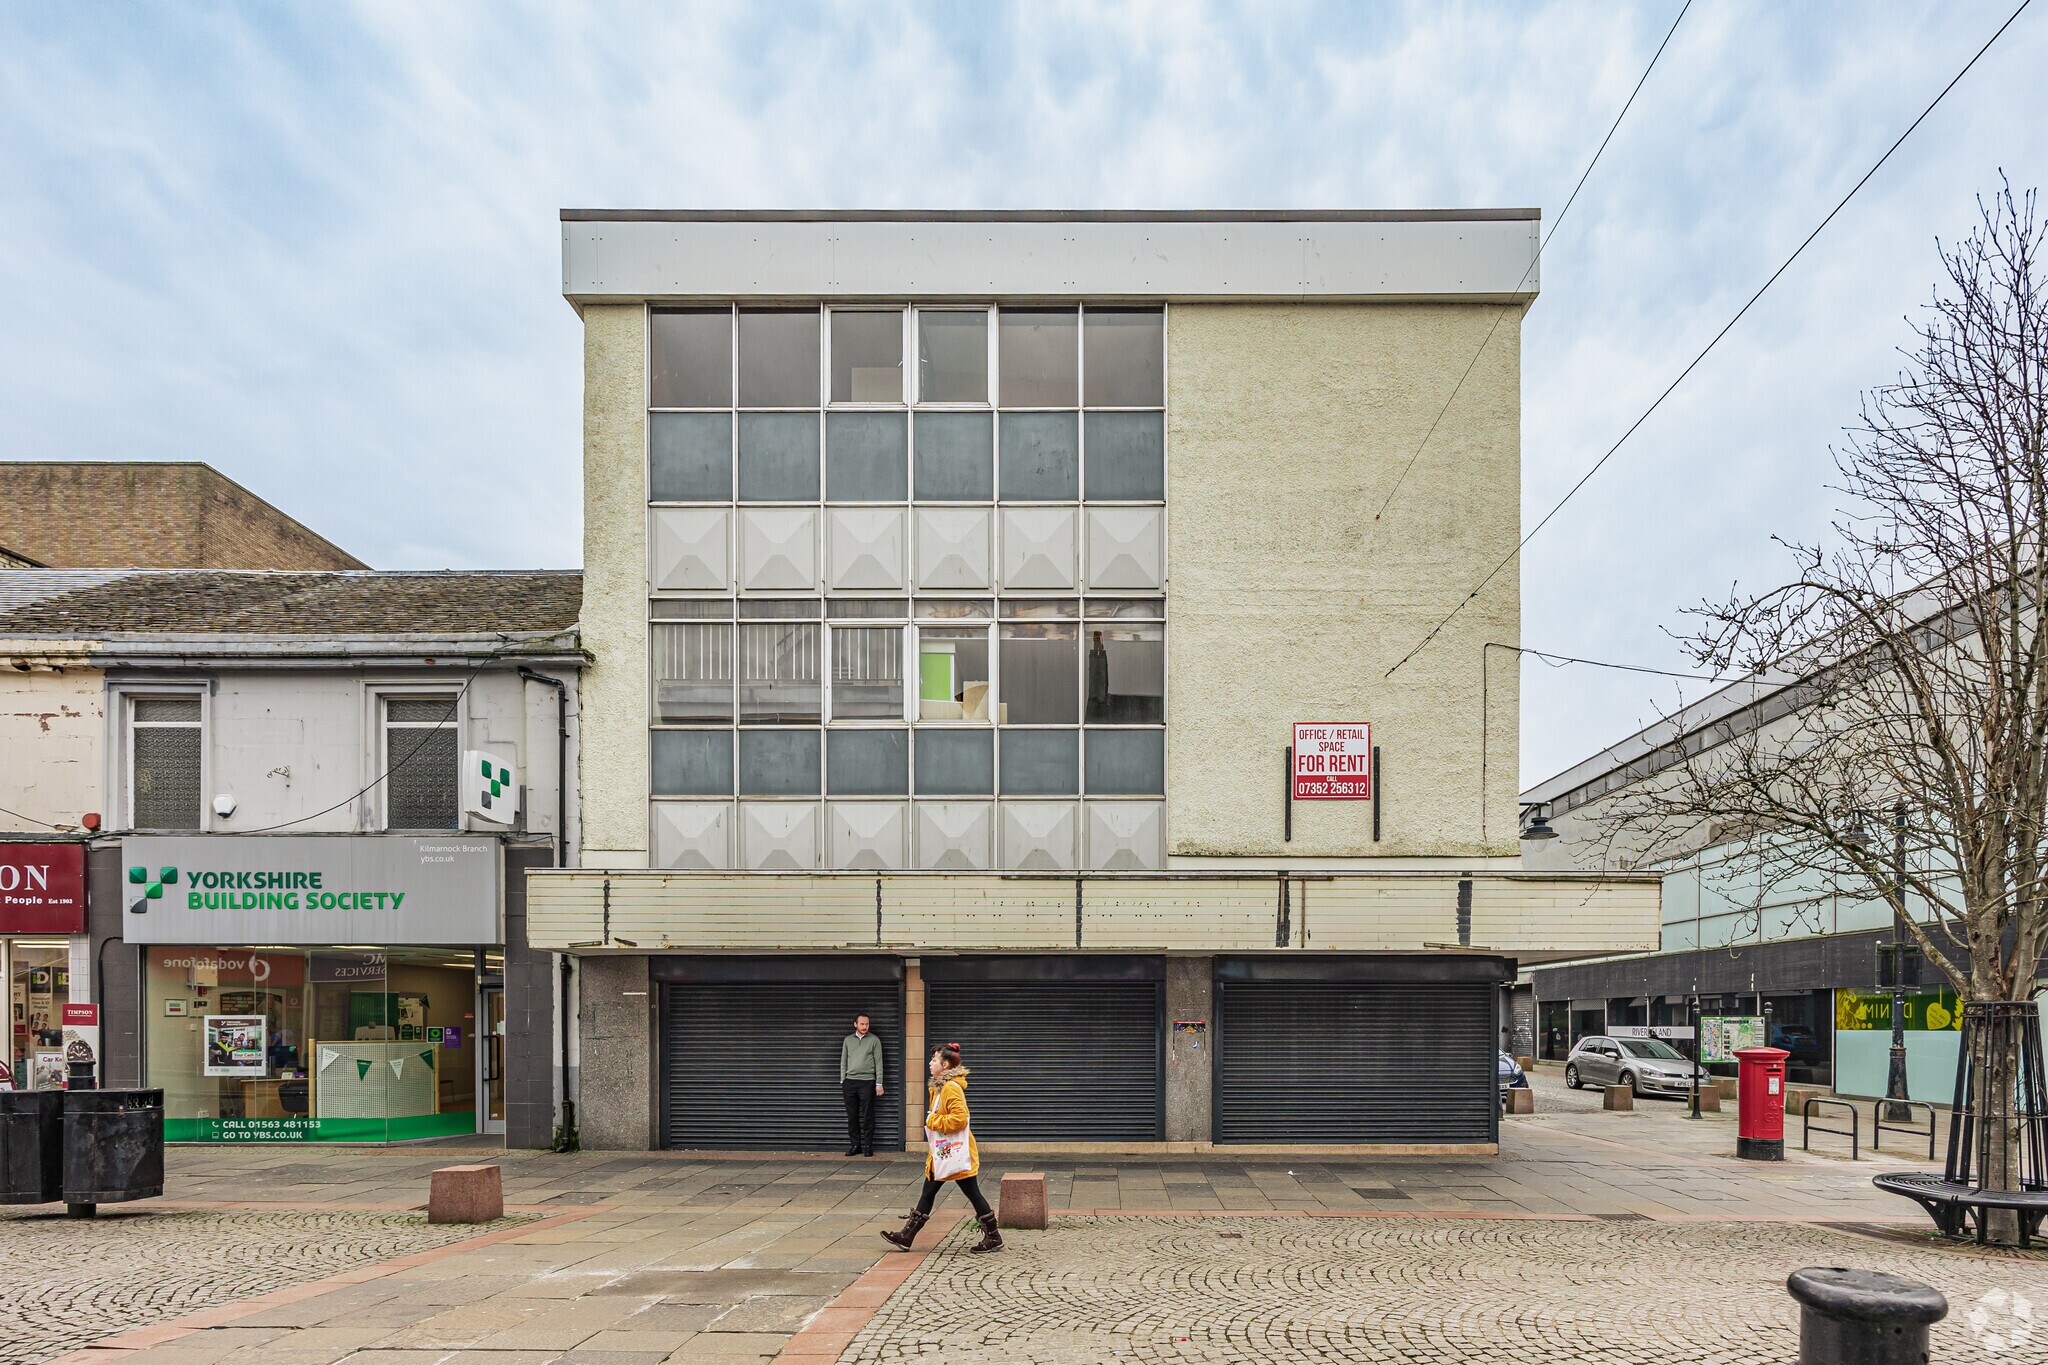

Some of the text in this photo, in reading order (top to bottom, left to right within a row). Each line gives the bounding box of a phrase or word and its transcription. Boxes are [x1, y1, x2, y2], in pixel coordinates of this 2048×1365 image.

[1299, 729, 1365, 740] OFFICE / RETAIL
[1318, 741, 1345, 752] SPACE
[1298, 755, 1366, 772] FOR RENT
[1298, 783, 1365, 794] 07352 256312
[419, 845, 488, 853] Kilmarnock Branch
[421, 855, 455, 864] ybs.co.uk
[187, 872, 323, 889] YORKSHIRE
[5, 896, 43, 906] People
[188, 892, 405, 910] BUILDING SOCIETY
[222, 1121, 321, 1129] CALL 01563 481153
[222, 1131, 303, 1139] GO TO YBS.CO.UK
